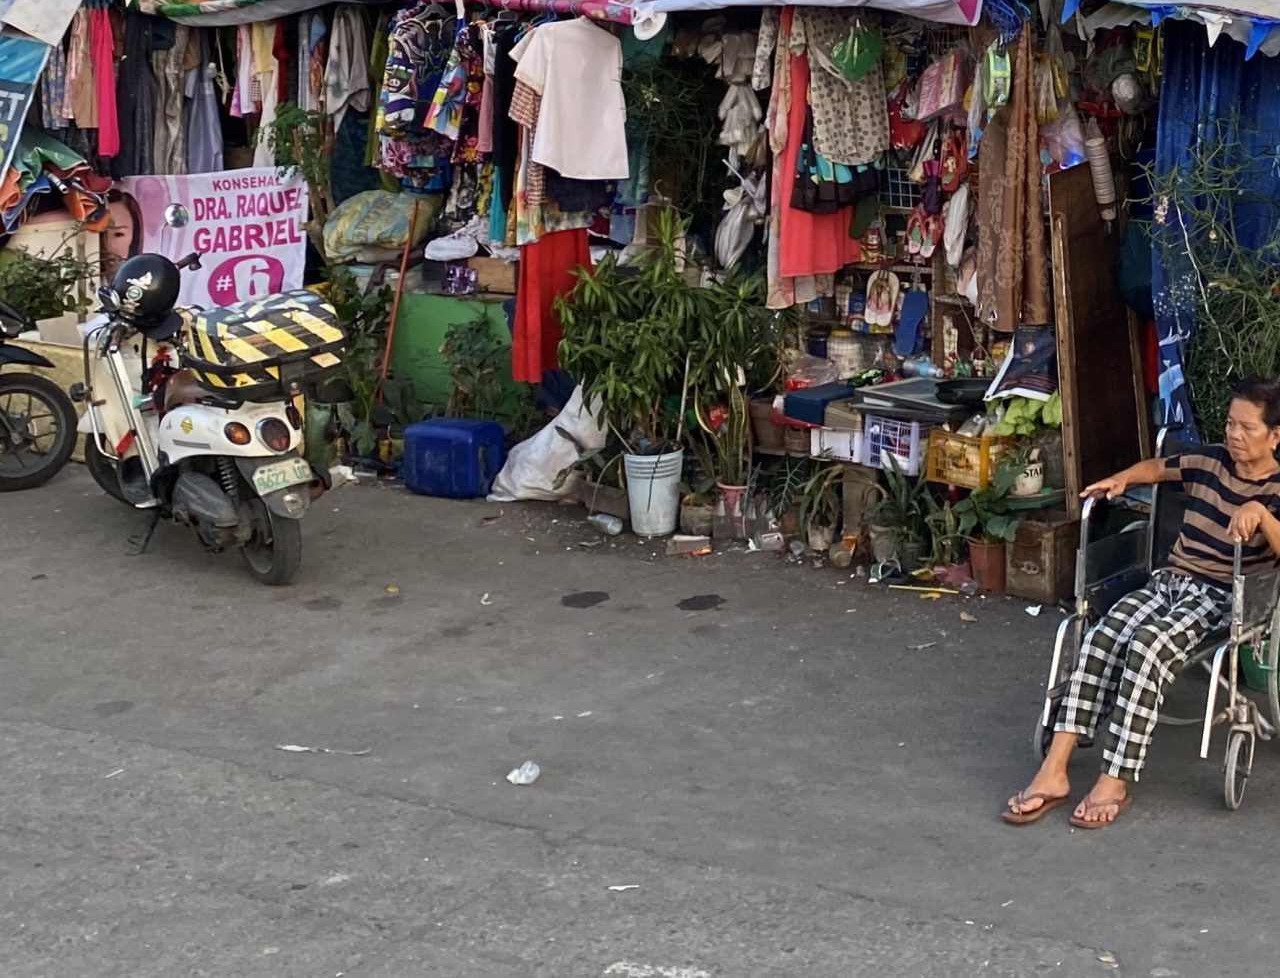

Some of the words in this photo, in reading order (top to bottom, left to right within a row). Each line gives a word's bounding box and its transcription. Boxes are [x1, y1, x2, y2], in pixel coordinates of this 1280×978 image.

[193, 196, 232, 221] DRA.
[237, 187, 302, 218] RAQUEL
[193, 217, 302, 254] GABRIEL
